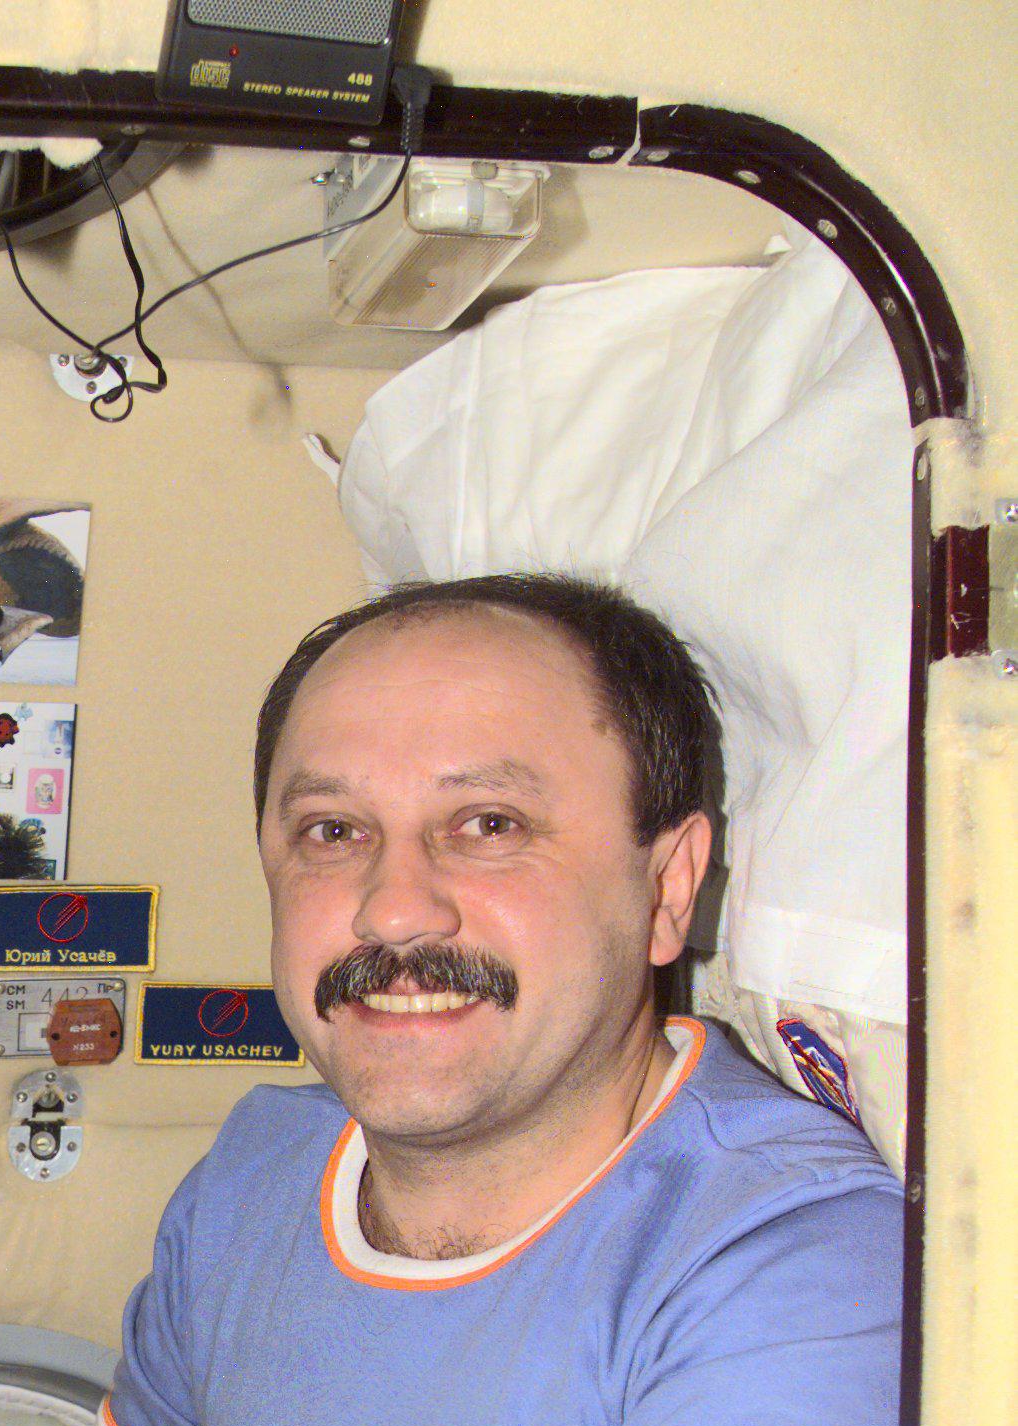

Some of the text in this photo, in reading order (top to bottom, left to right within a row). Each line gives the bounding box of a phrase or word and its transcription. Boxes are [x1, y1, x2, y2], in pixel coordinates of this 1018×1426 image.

[347, 72, 373, 86] 488
[243, 81, 282, 95] STEREO
[285, 86, 329, 99] SPEAKER
[332, 91, 370, 103] SYSTEM
[5, 949, 116, 965] Юрий Усачёв
[7, 1000, 25, 1010] SM
[150, 1044, 282, 1058] YURY USACHEV
